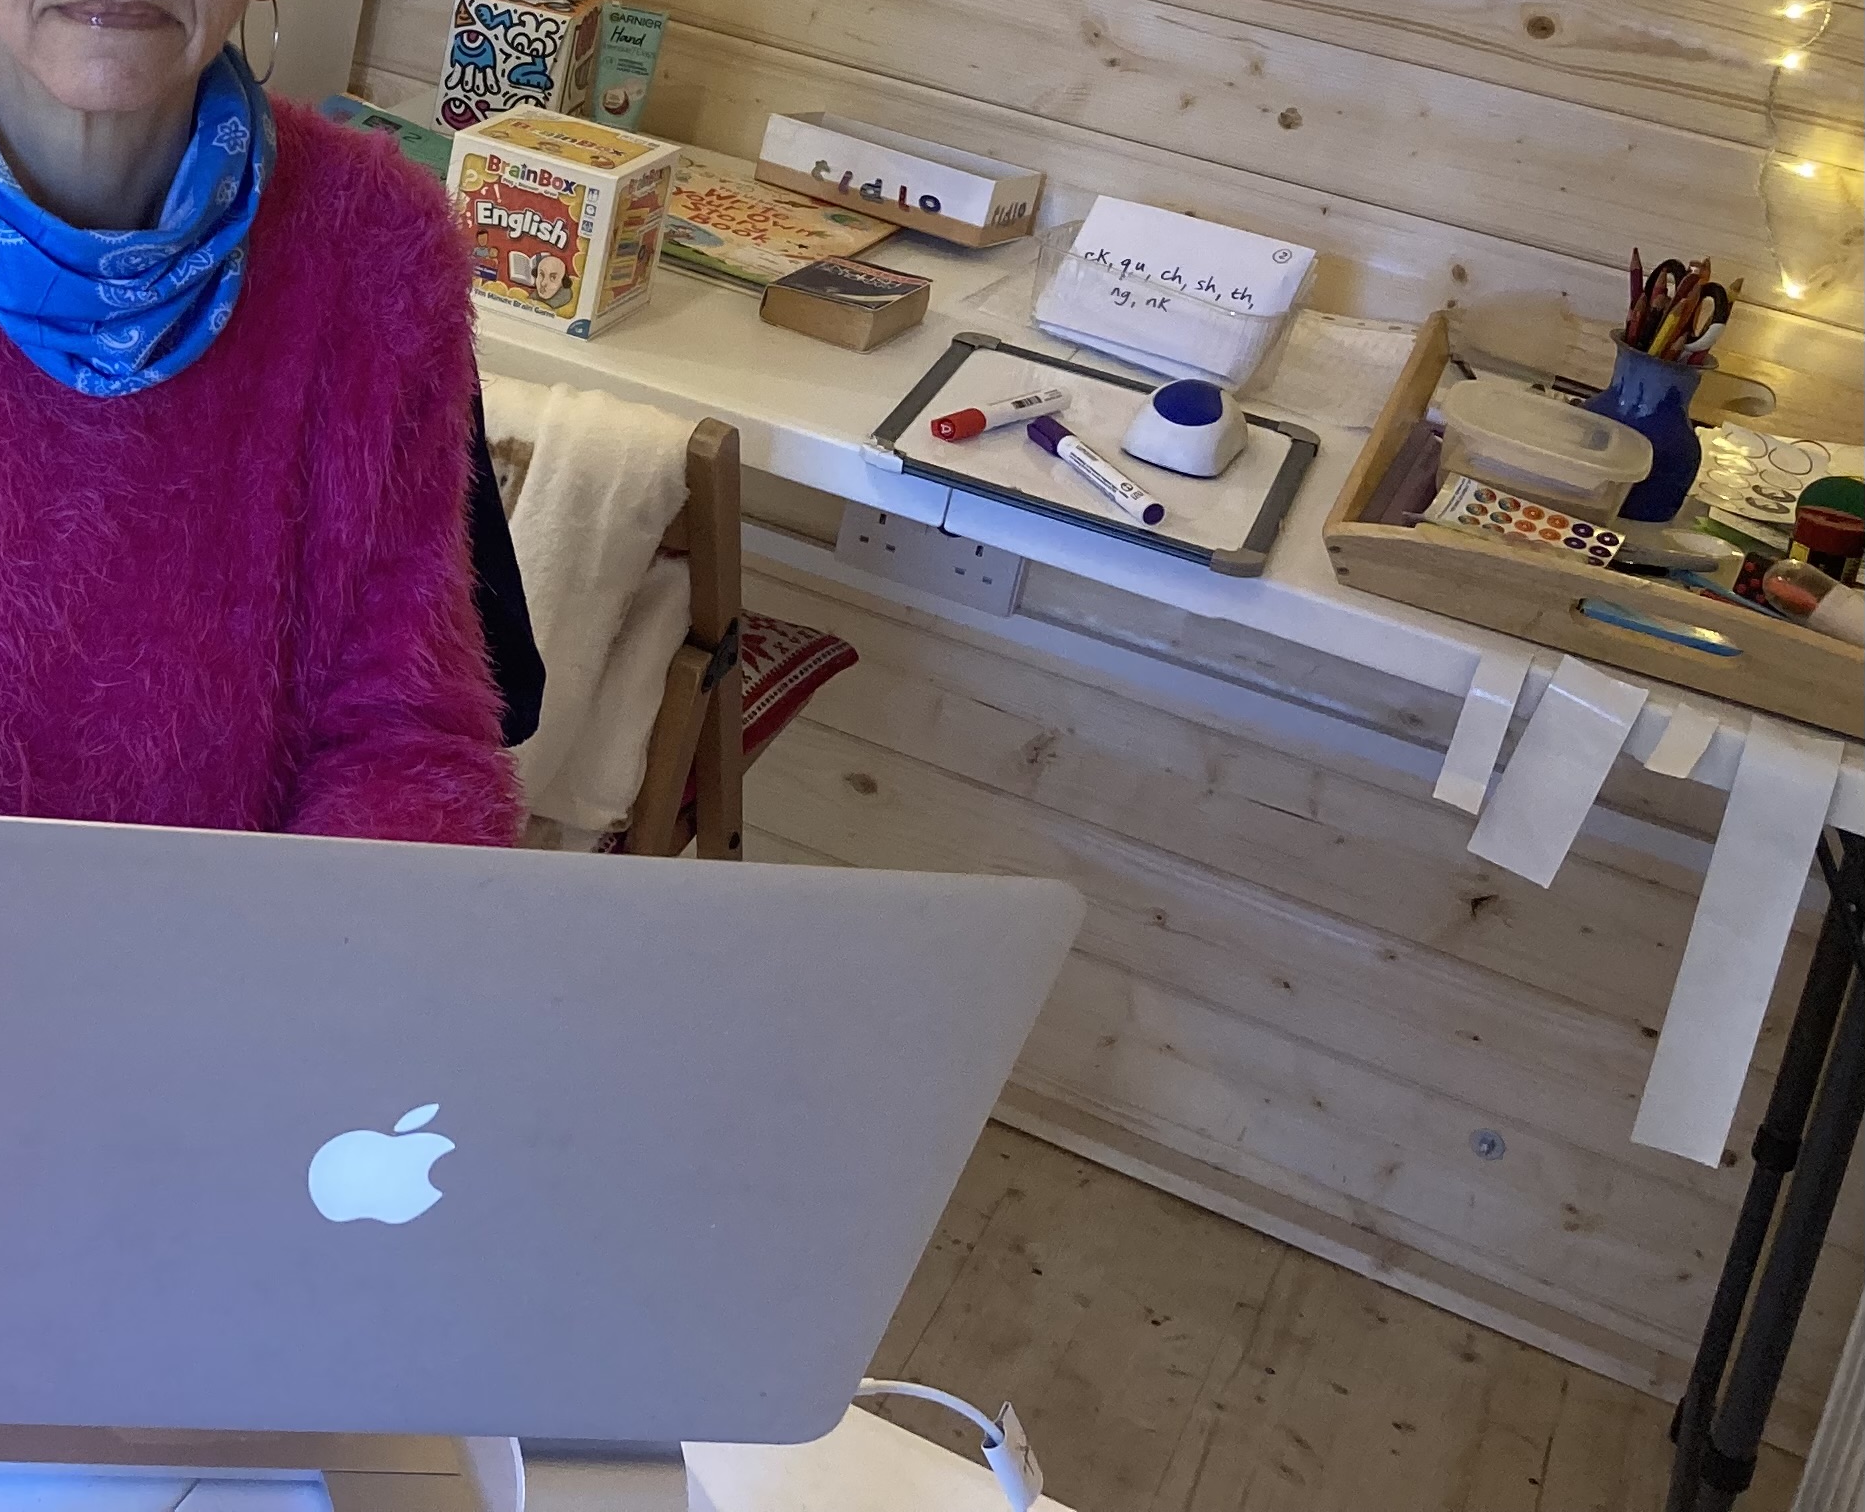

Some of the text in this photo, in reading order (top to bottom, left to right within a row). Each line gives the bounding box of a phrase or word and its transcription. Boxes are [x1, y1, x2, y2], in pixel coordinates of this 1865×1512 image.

[610, 26, 646, 47] Hand
[487, 154, 576, 196] BrainBox
[476, 201, 568, 250] English
[1110, 288, 1136, 308] ng,
[1161, 267, 1187, 291] ch,
[1197, 276, 1221, 301] sh,
[1231, 288, 1253, 310] th,
[512, 300, 533, 312] Brain
[534, 307, 555, 319] Game
